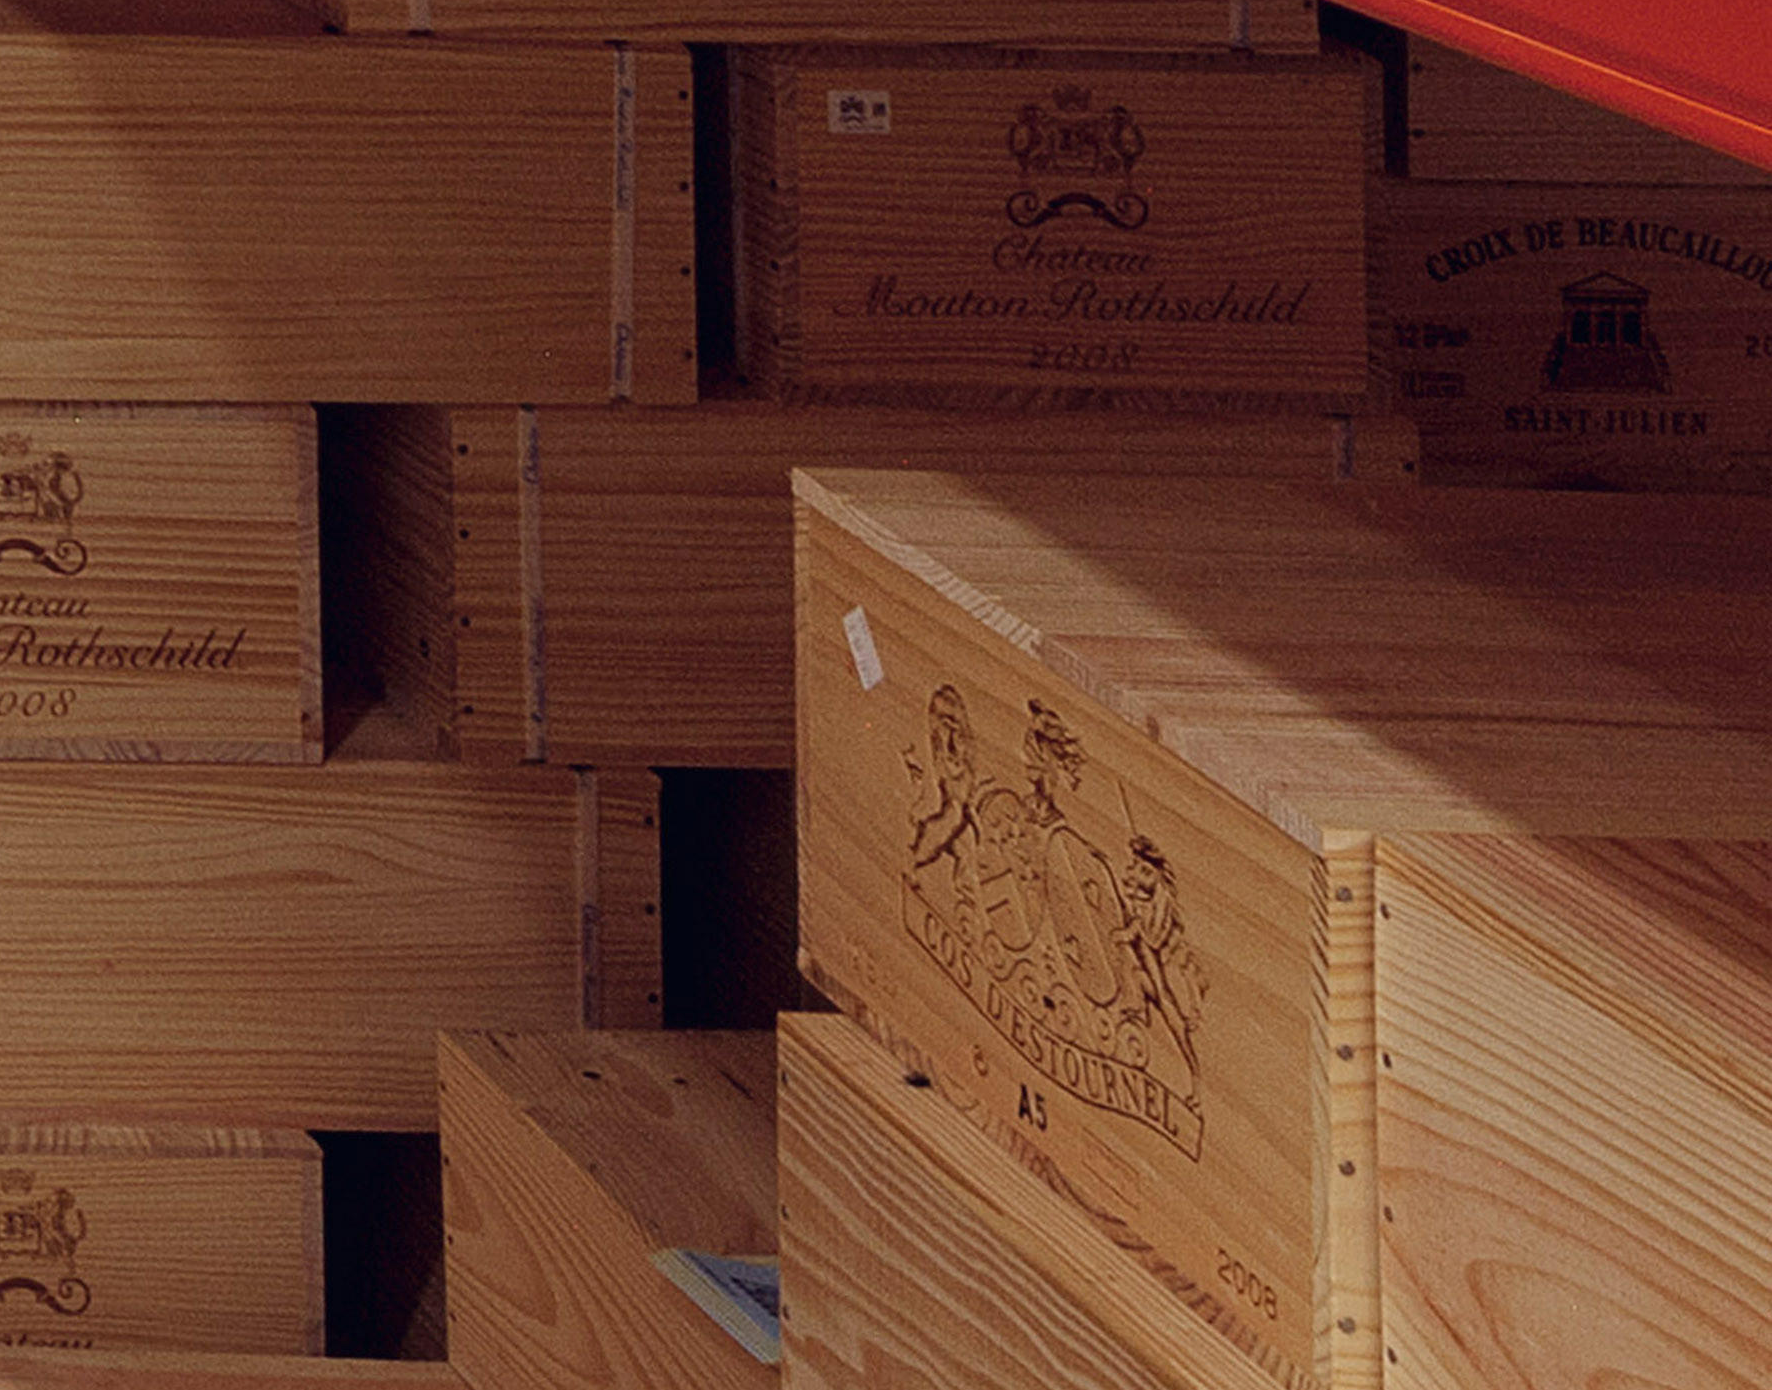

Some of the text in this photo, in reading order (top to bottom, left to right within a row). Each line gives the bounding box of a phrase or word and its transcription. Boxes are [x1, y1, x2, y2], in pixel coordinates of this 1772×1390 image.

[1425, 226, 1517, 285] CROIX
[1524, 220, 1566, 255] DE
[835, 277, 1313, 327] Mouton Rothschild
[1503, 407, 1708, 437] SAINT-JULIEN
[921, 913, 978, 990] COS
[1016, 1082, 1050, 1134] A5
